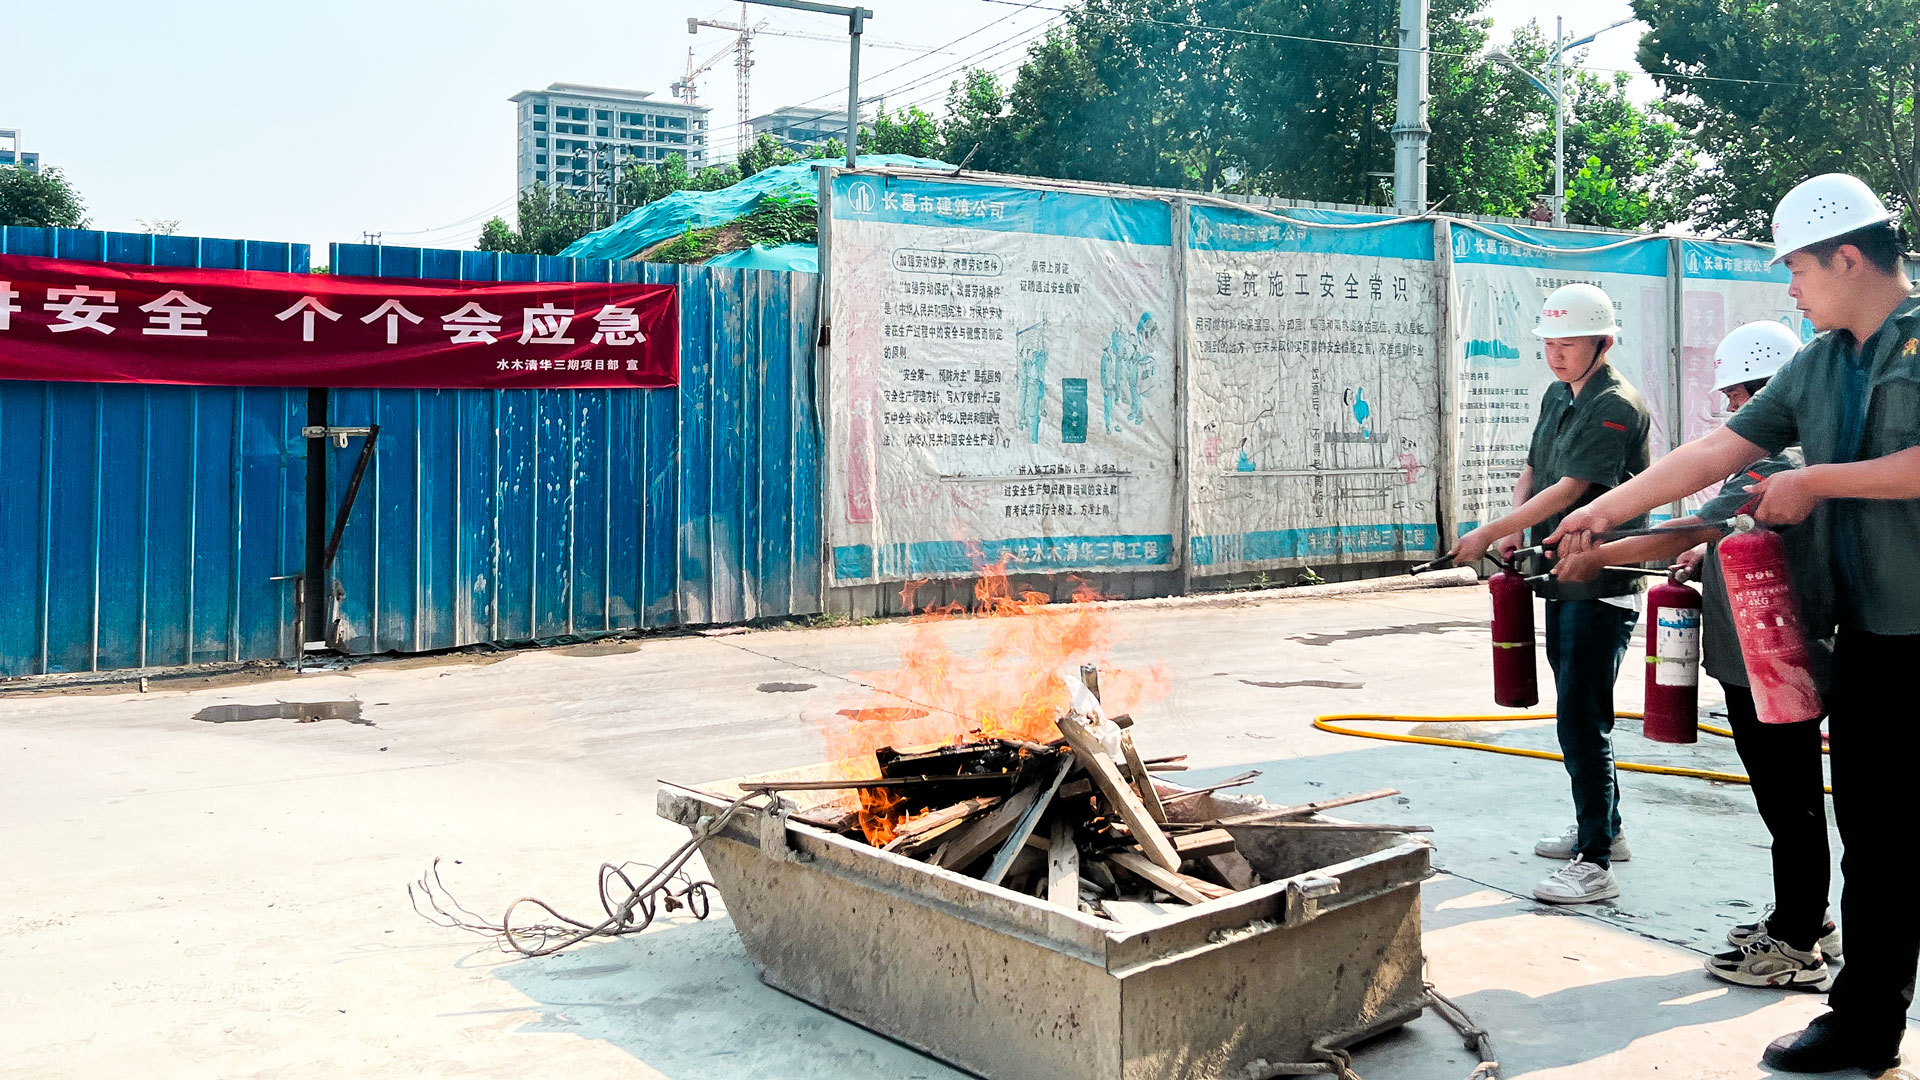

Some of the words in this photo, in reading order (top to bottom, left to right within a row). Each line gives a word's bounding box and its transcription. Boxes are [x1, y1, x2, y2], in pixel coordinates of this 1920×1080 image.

[881, 190, 1005, 220] 长葛市建筑公司
[1216, 270, 1408, 301] 建筑施工安全常识
[0, 281, 213, 337] 安全
[275, 296, 647, 346] 个个会应急
[496, 358, 619, 372] 水木清华三期项目部
[626, 359, 639, 371] 宣
